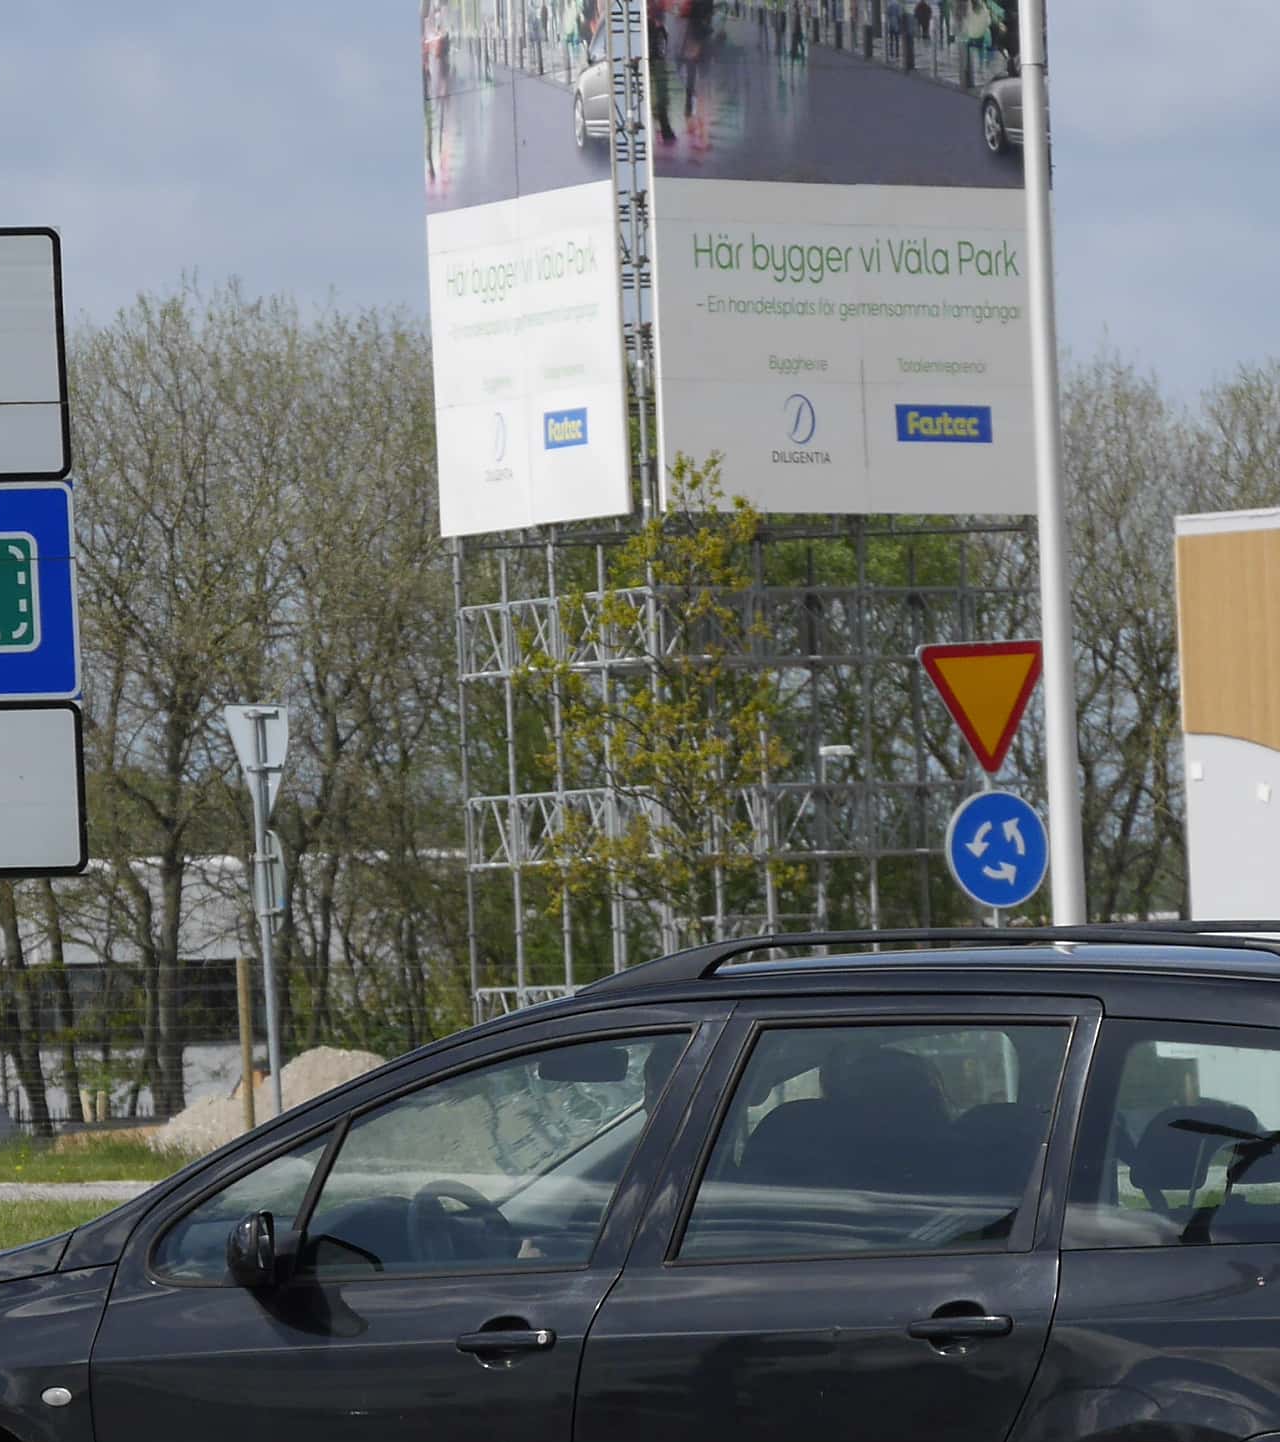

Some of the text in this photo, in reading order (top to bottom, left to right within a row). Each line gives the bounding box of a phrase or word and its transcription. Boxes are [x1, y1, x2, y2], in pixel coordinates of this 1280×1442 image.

[692, 231, 1019, 284] Här bygger vi Väla Park
[906, 411, 980, 437] Fastec
[771, 450, 832, 465] DILIGENTIA
